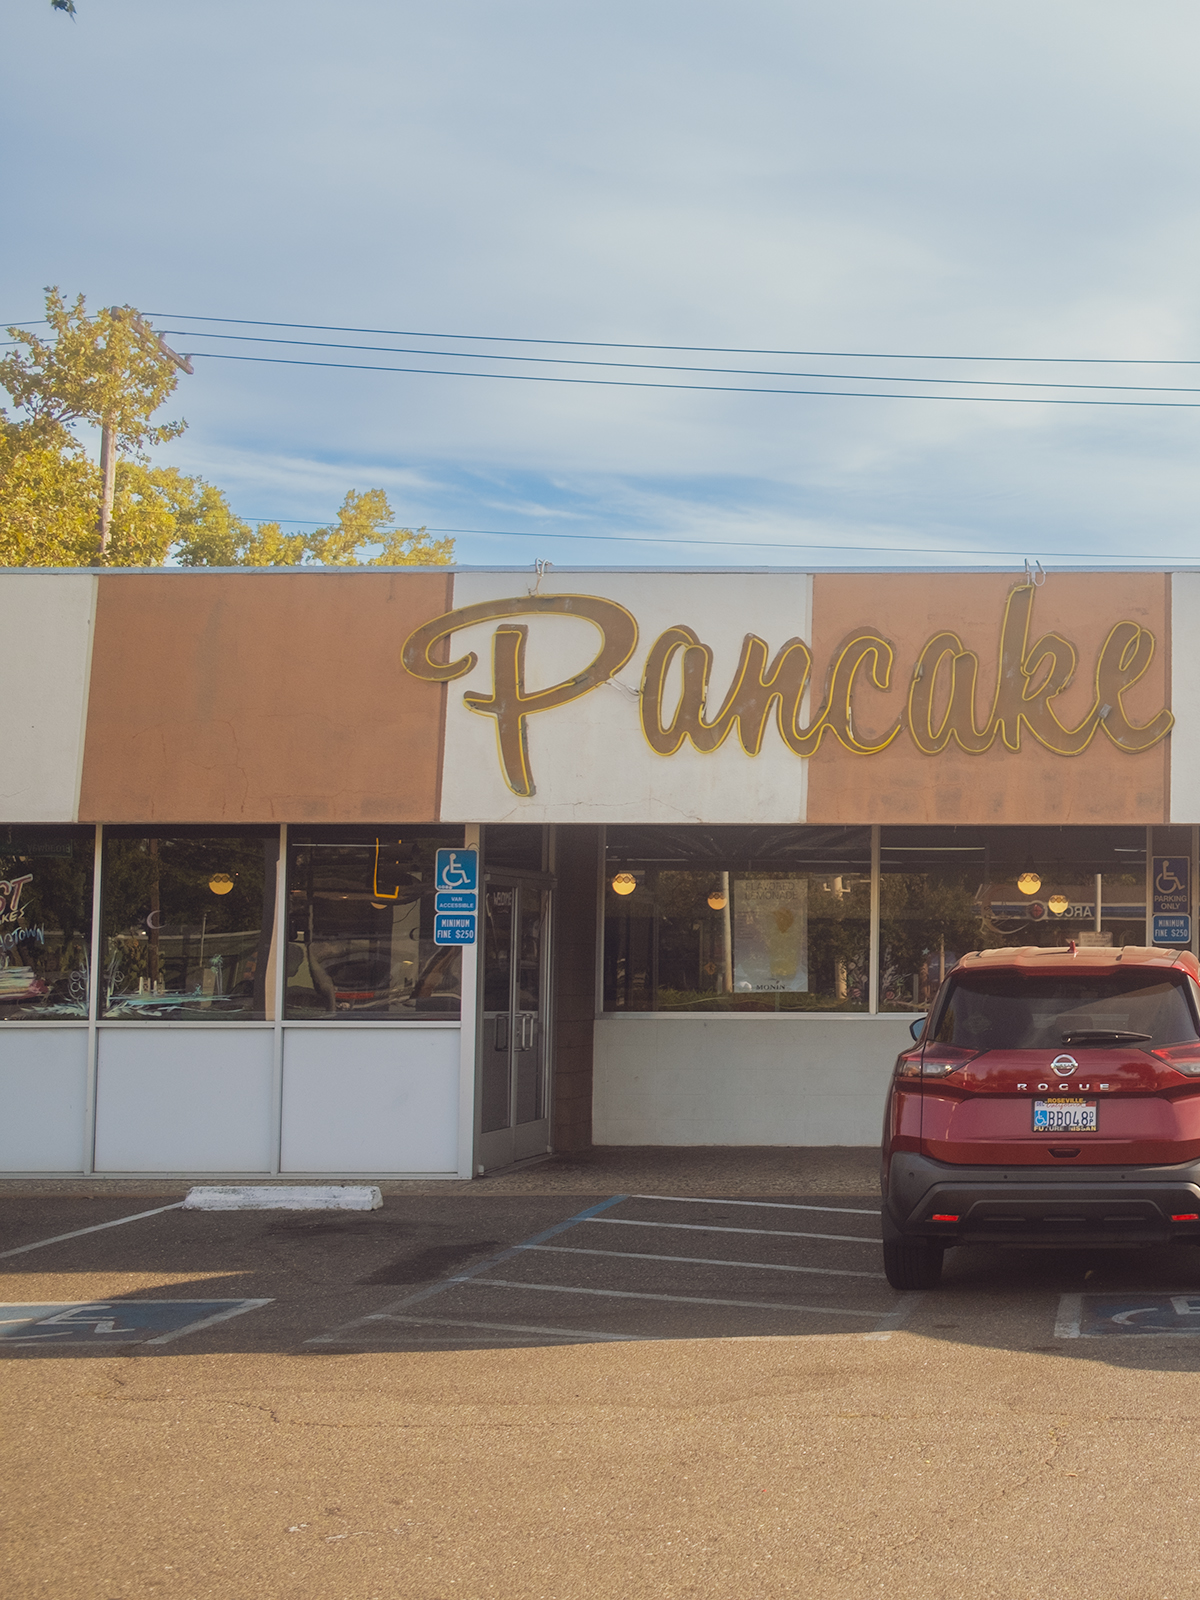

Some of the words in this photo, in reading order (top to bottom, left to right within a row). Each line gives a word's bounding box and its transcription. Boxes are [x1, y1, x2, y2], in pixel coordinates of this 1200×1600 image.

[402, 584, 1174, 798] Pancake
[744, 891, 798, 900] LEMONADE
[1154, 895, 1187, 903] PARKING
[441, 919, 470, 928] MINIMUM
[1158, 919, 1185, 927] MINIMUM
[437, 930, 451, 938] FINE
[455, 929, 474, 939] $250
[1155, 929, 1168, 938] FINE
[1171, 929, 1188, 938] $250
[1017, 1083, 1110, 1091] ROGUE
